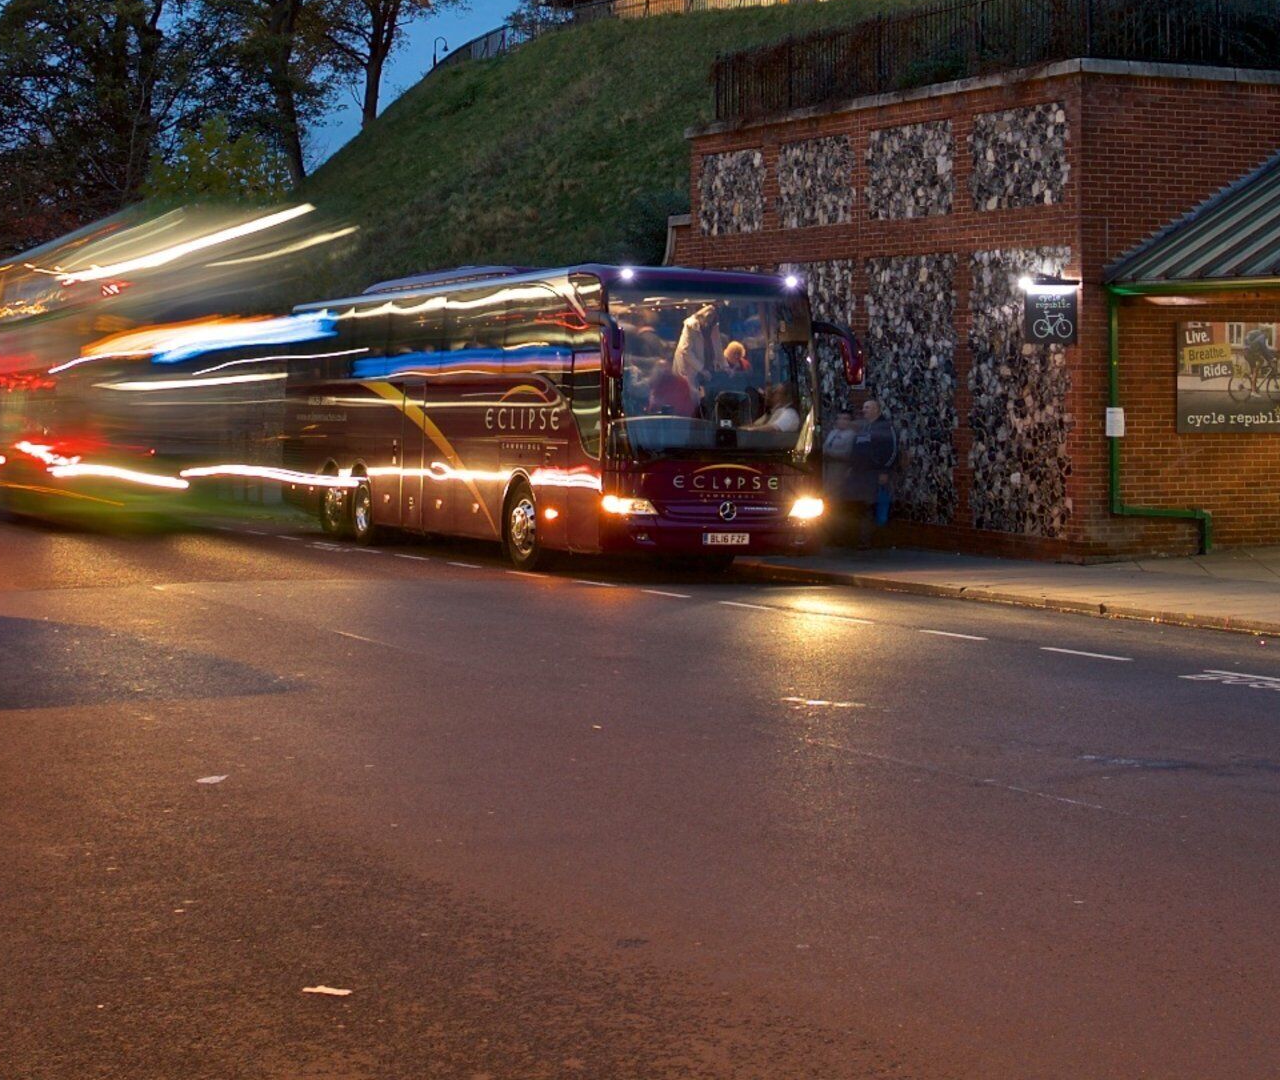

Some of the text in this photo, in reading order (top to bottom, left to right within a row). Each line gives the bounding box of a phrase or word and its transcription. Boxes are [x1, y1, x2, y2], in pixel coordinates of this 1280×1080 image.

[1185, 330, 1210, 345] Live.
[1188, 347, 1228, 361] Breathe.
[1203, 364, 1232, 378] Ride.
[485, 408, 561, 431] ECLIPSE
[1187, 412, 1226, 427] cycle
